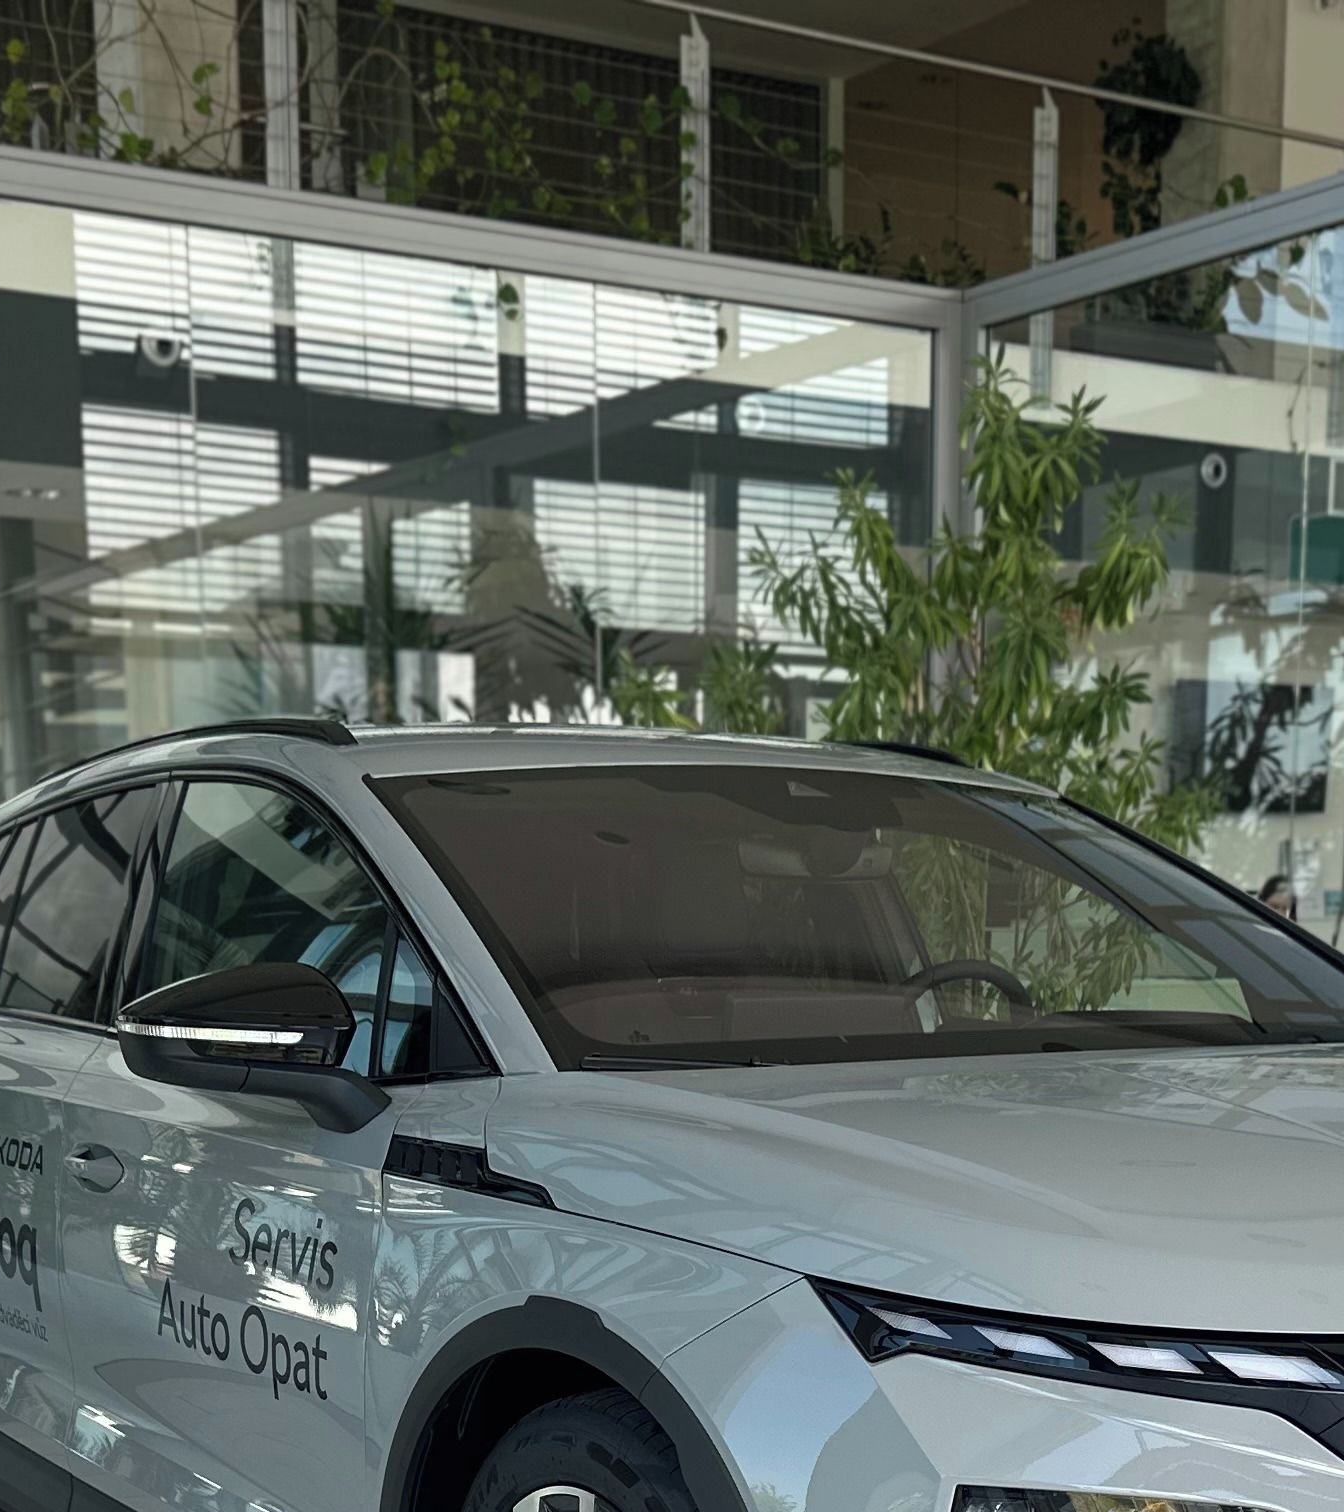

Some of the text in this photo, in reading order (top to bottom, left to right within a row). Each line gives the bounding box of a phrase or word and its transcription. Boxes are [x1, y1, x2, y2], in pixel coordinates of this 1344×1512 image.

[229, 1199, 339, 1293] Servis
[157, 1277, 329, 1401] Auto Opat
